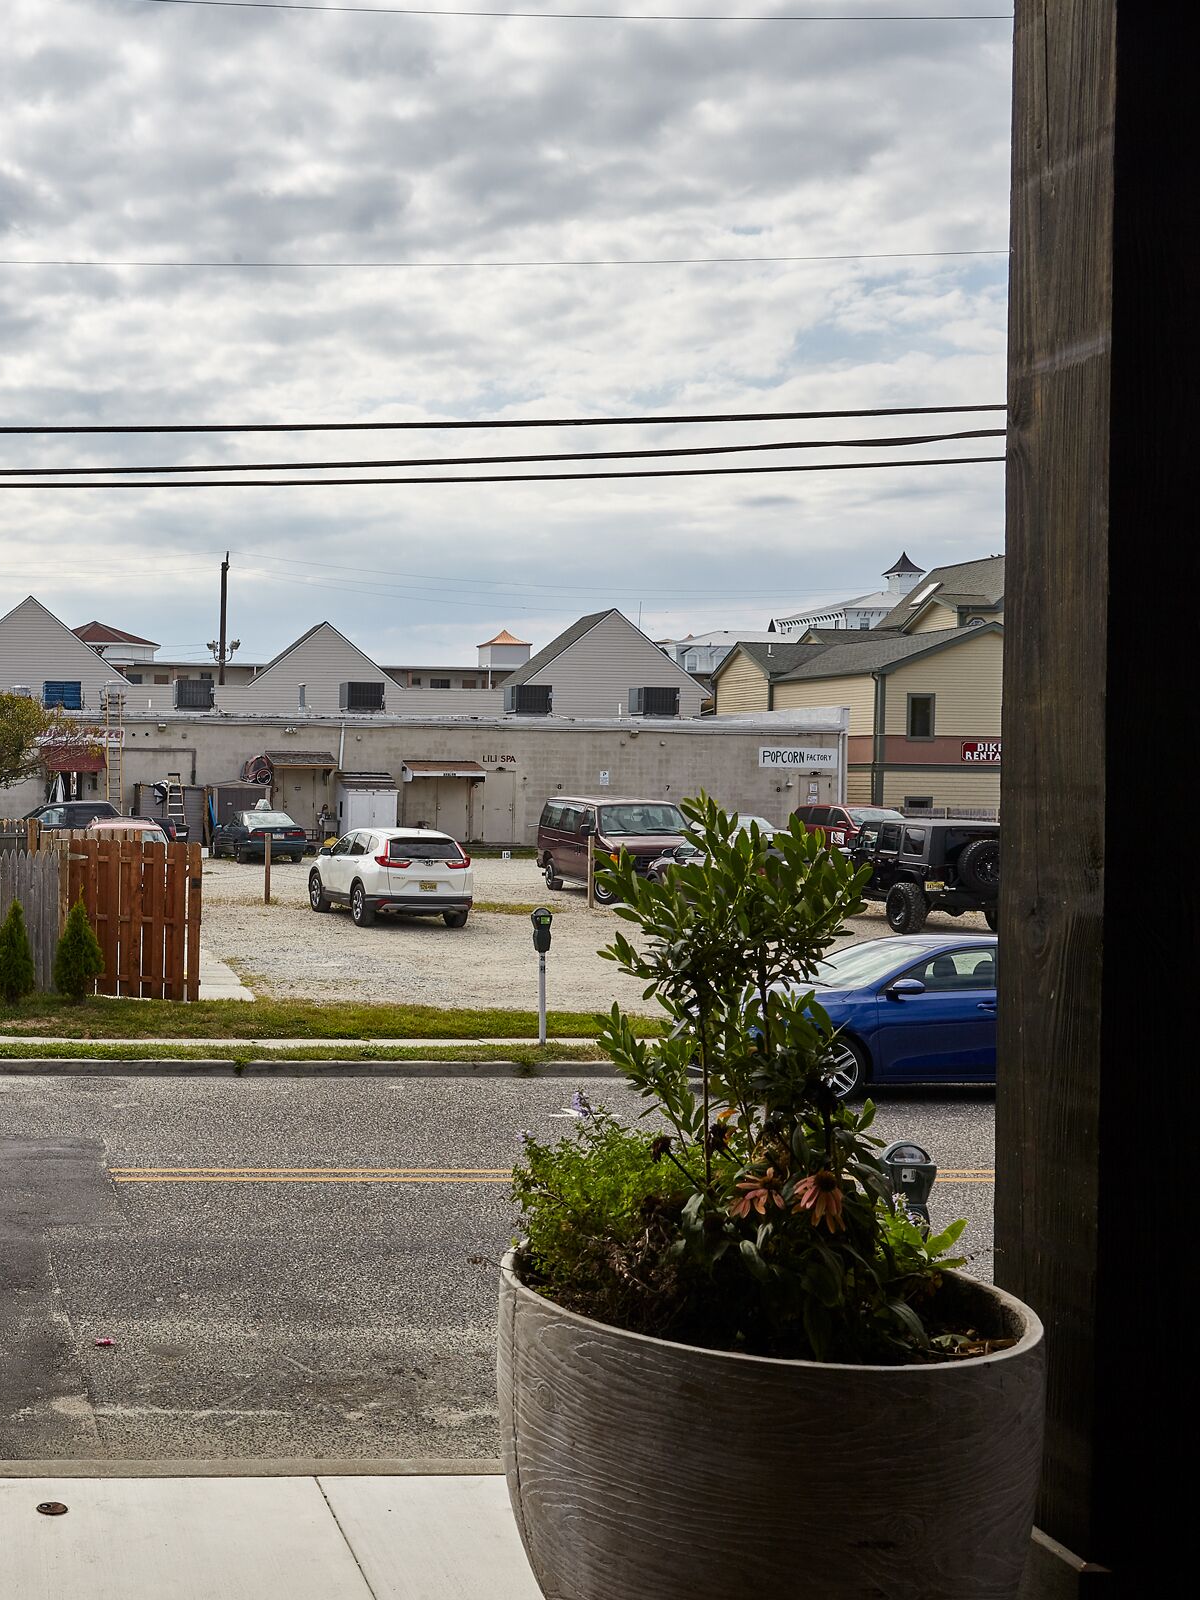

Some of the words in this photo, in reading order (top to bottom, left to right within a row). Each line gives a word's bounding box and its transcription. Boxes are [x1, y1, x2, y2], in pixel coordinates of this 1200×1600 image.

[500, 755, 517, 763] SPA
[762, 750, 805, 764] POPCORN
[806, 753, 832, 762] FACTORY
[503, 850, 510, 859] 15
